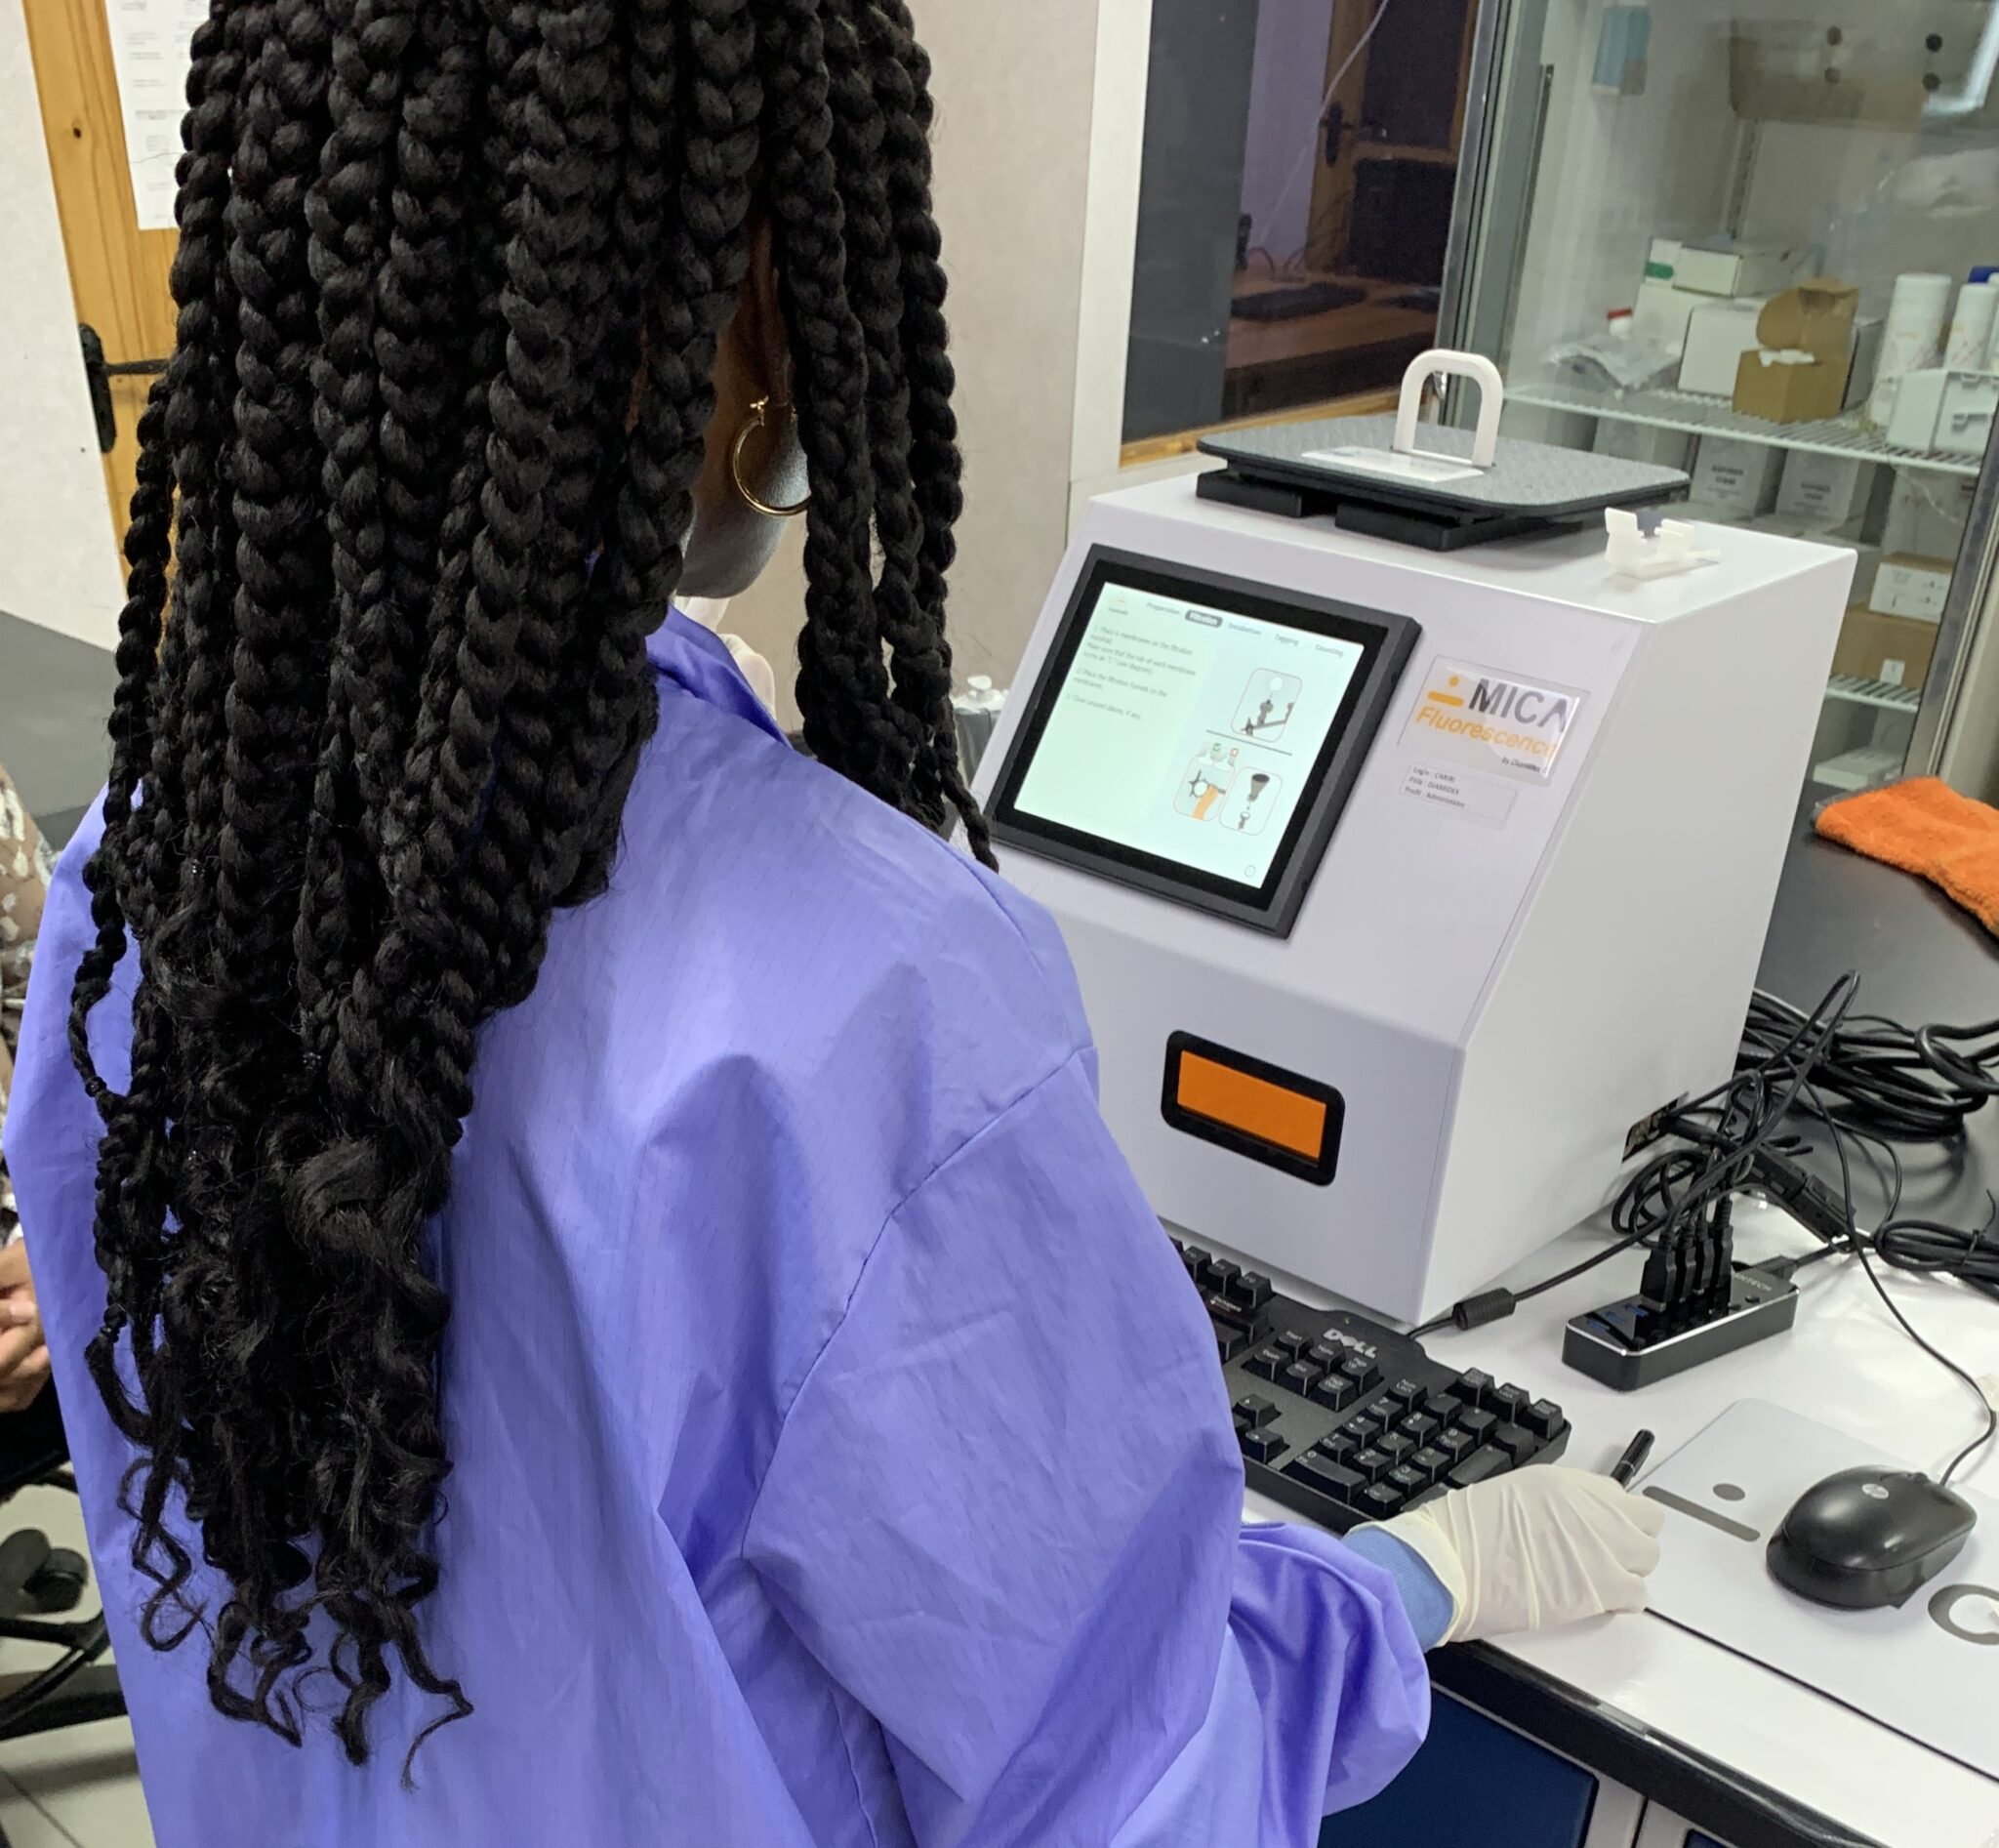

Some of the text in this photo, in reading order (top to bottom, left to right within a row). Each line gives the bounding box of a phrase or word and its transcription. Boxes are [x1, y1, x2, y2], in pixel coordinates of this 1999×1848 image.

[1189, 613, 1219, 627] Filtration
[1468, 678, 1568, 732] MICA
[1324, 1328, 1377, 1359] DELL
